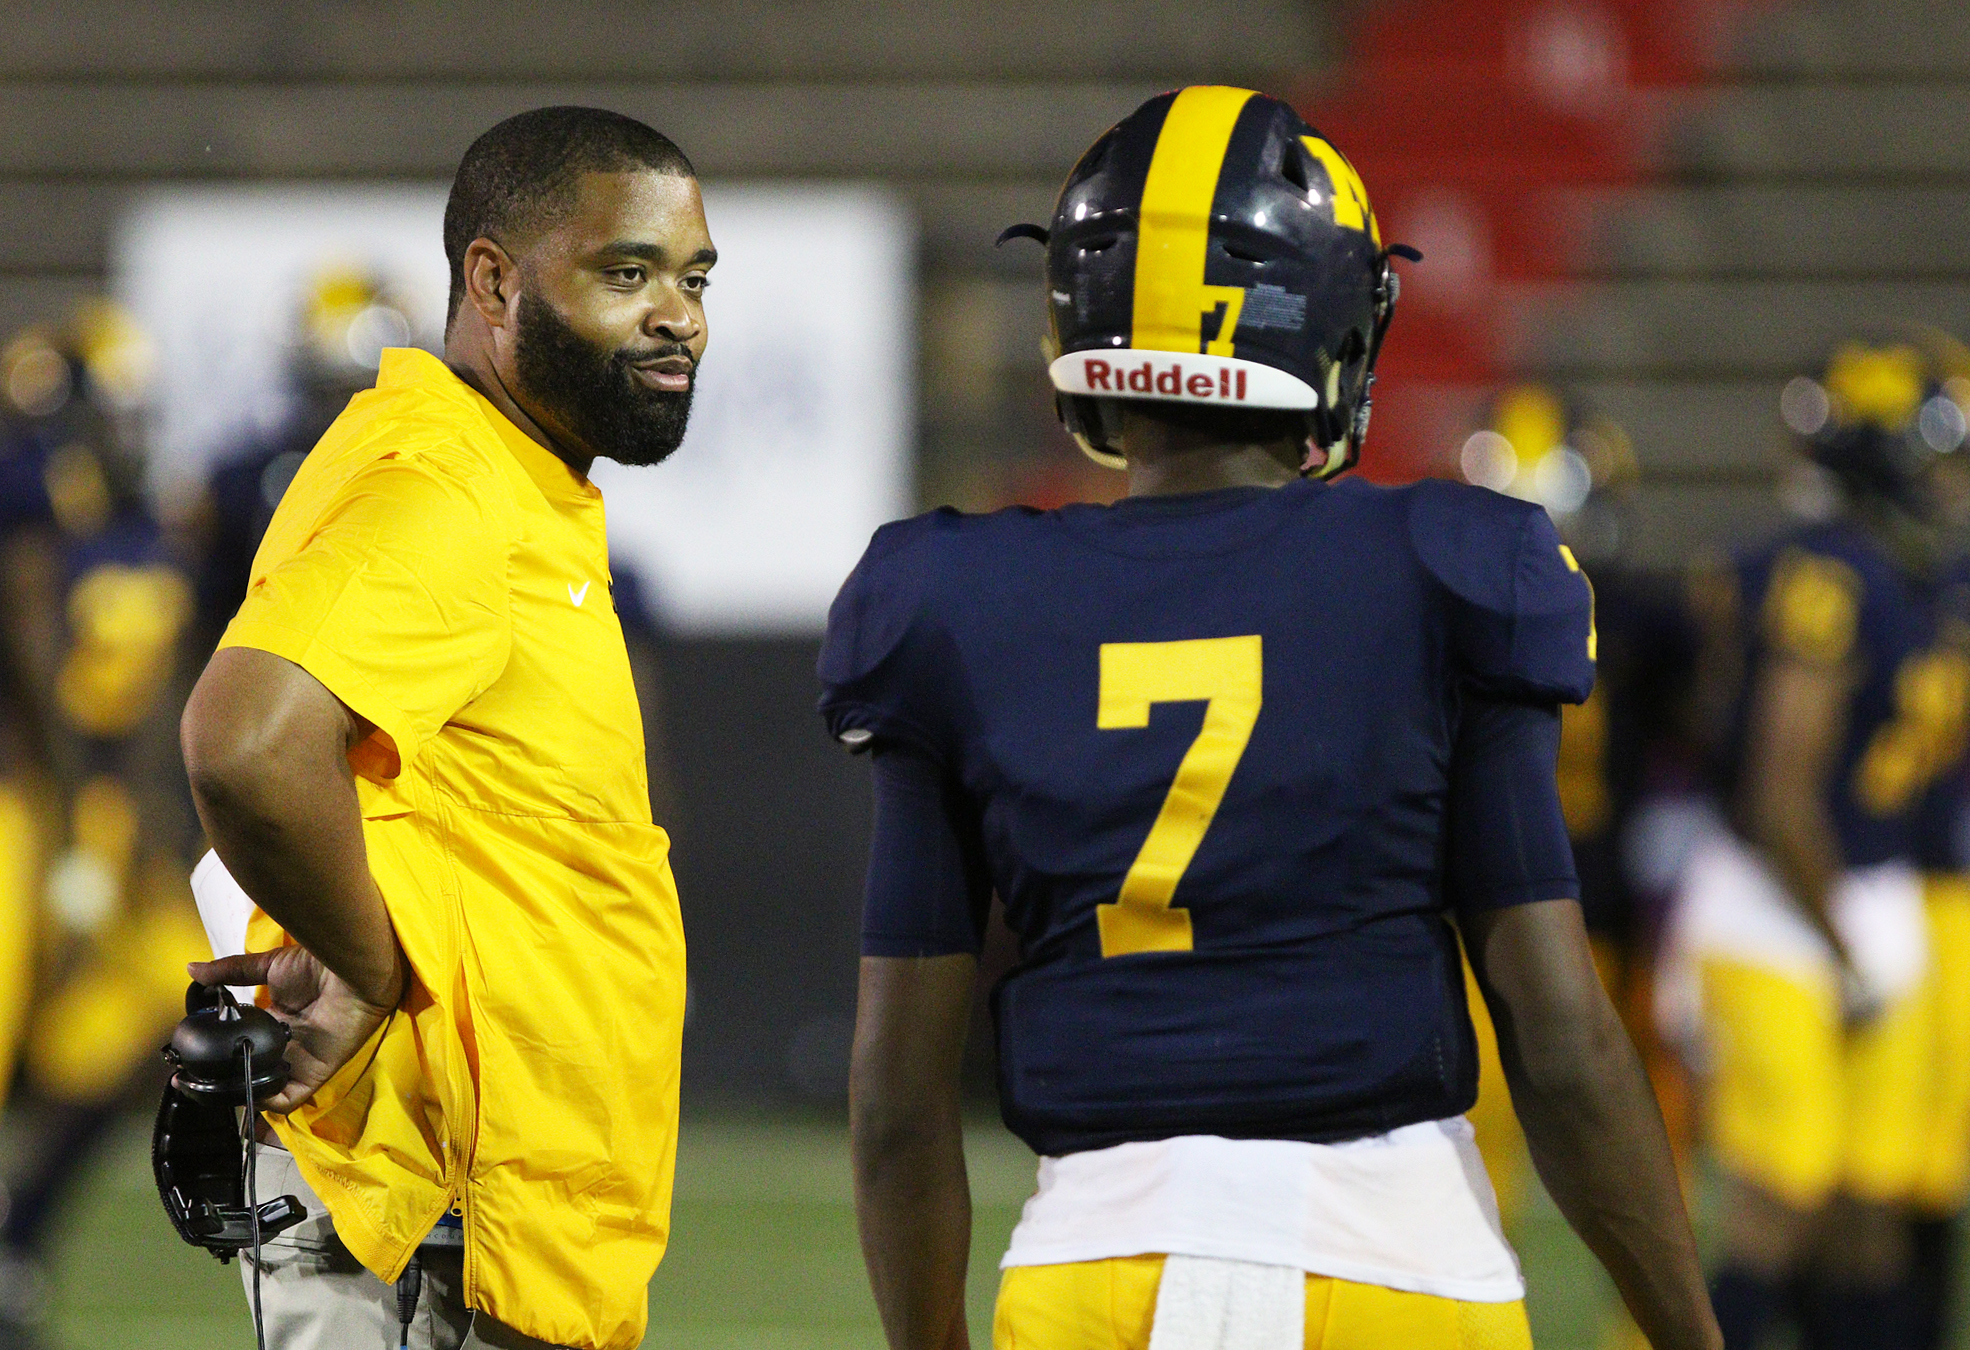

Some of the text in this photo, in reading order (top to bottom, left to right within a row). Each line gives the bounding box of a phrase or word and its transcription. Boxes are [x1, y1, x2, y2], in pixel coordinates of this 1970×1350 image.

[1202, 285, 1245, 357] 7
[1084, 359, 1247, 401] Riddell
[1097, 635, 1262, 957] 7
